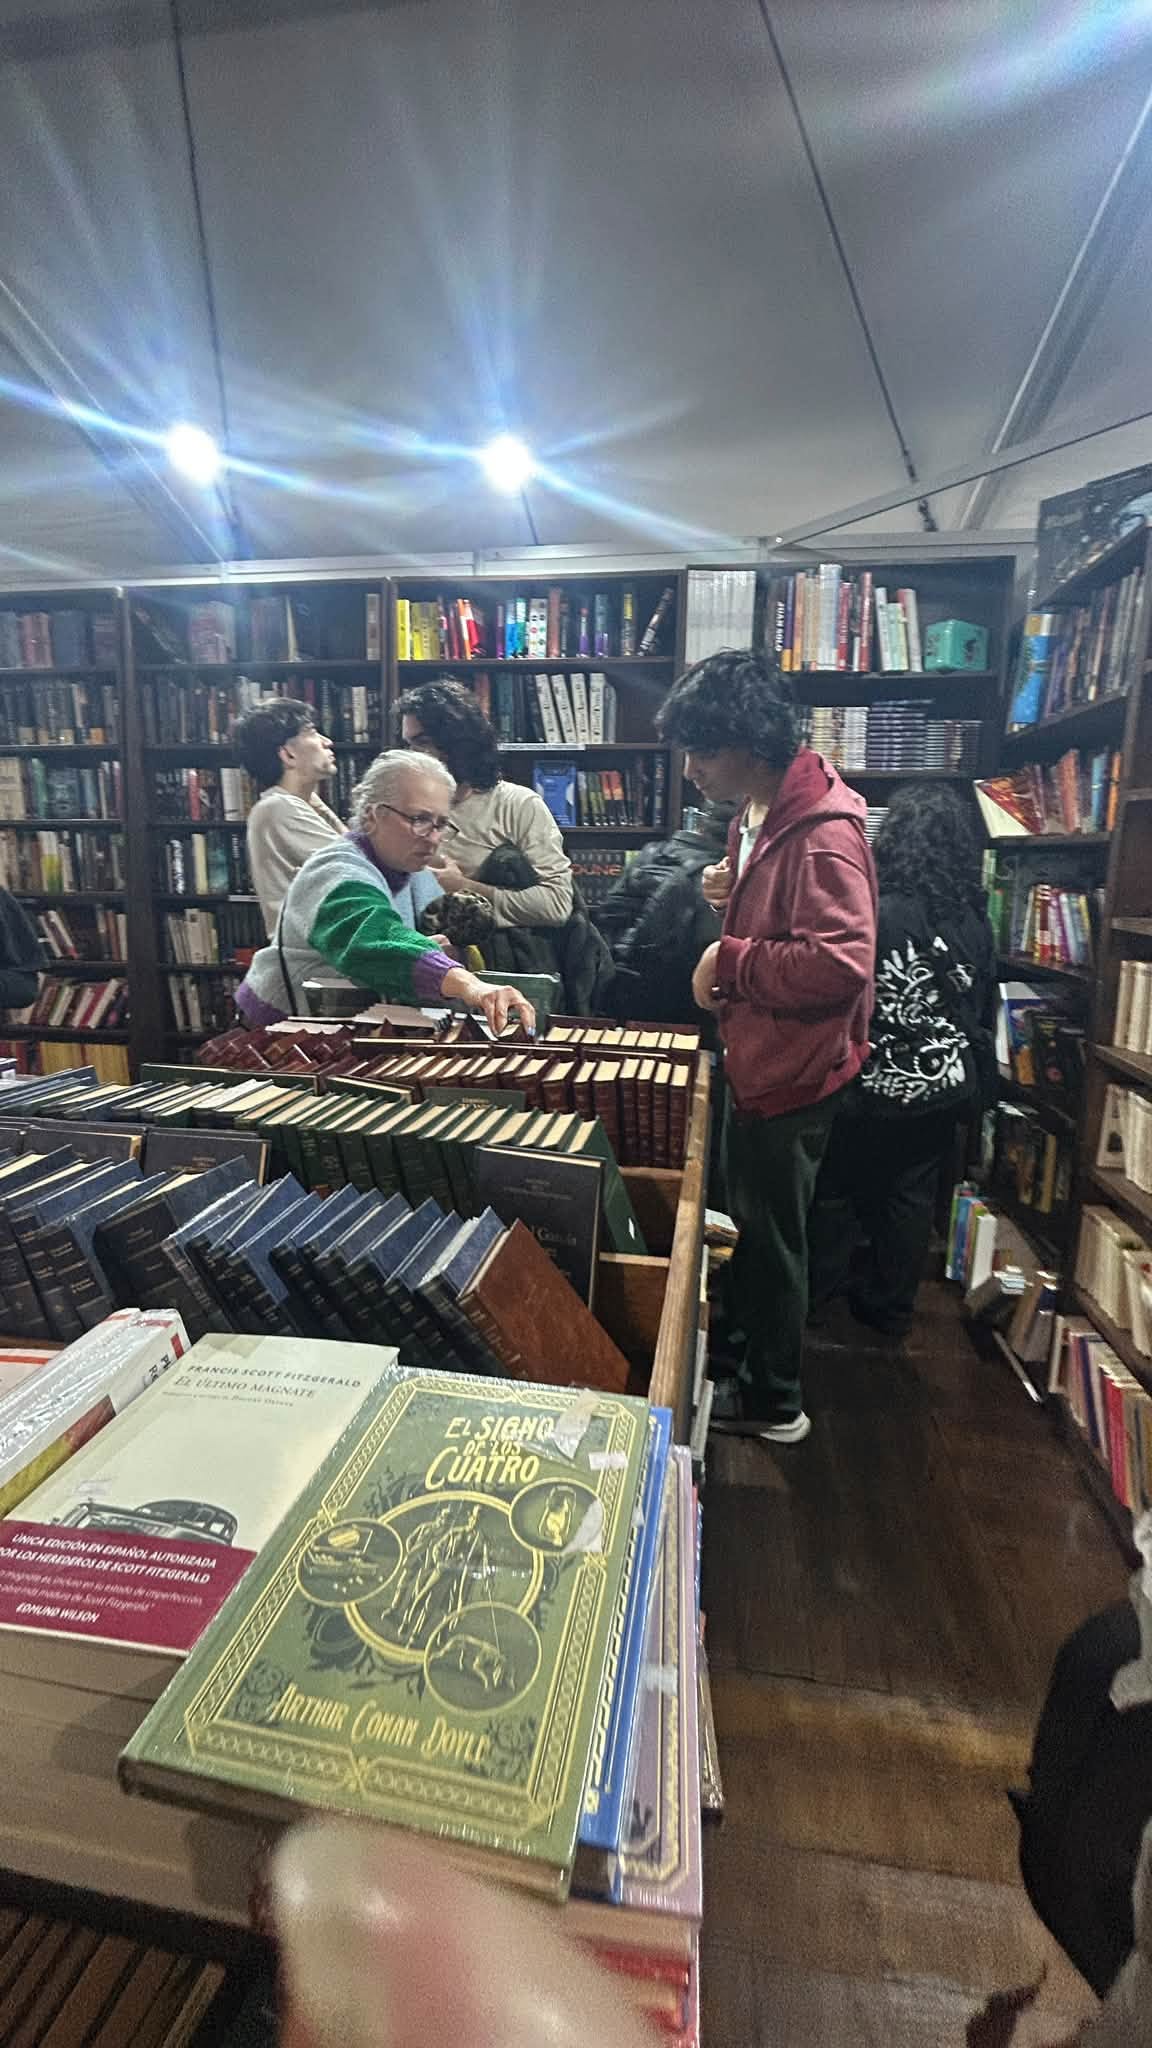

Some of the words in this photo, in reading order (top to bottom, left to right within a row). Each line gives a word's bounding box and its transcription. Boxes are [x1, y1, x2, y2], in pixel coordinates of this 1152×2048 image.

[188, 1365, 237, 1376] FRANCIS
[240, 1368, 281, 1379] SCOTT
[283, 1371, 361, 1388] FITZGERALD
[249, 1383, 315, 1398] MAGNATE
[474, 1415, 555, 1442] SIGNO
[463, 1439, 486, 1456] DE
[490, 1440, 521, 1456] LOS
[425, 1446, 540, 1491] CUATRO
[44, 1537, 89, 1552] EDICIÓN
[87, 1542, 104, 1554] EN
[102, 1545, 148, 1560] ESPAÑOL
[149, 1551, 217, 1569] AUTORIZADA
[16, 1550, 38, 1561] LOS
[36, 1552, 96, 1569] HEREDEROS
[95, 1559, 113, 1571] DE
[111, 1561, 147, 1575] SCOTT
[145, 1566, 210, 1584] FITZGERALD
[16, 1601, 61, 1617] EDMUND
[59, 1607, 100, 1623] WILSON
[421, 1715, 491, 1768] DOYLE
